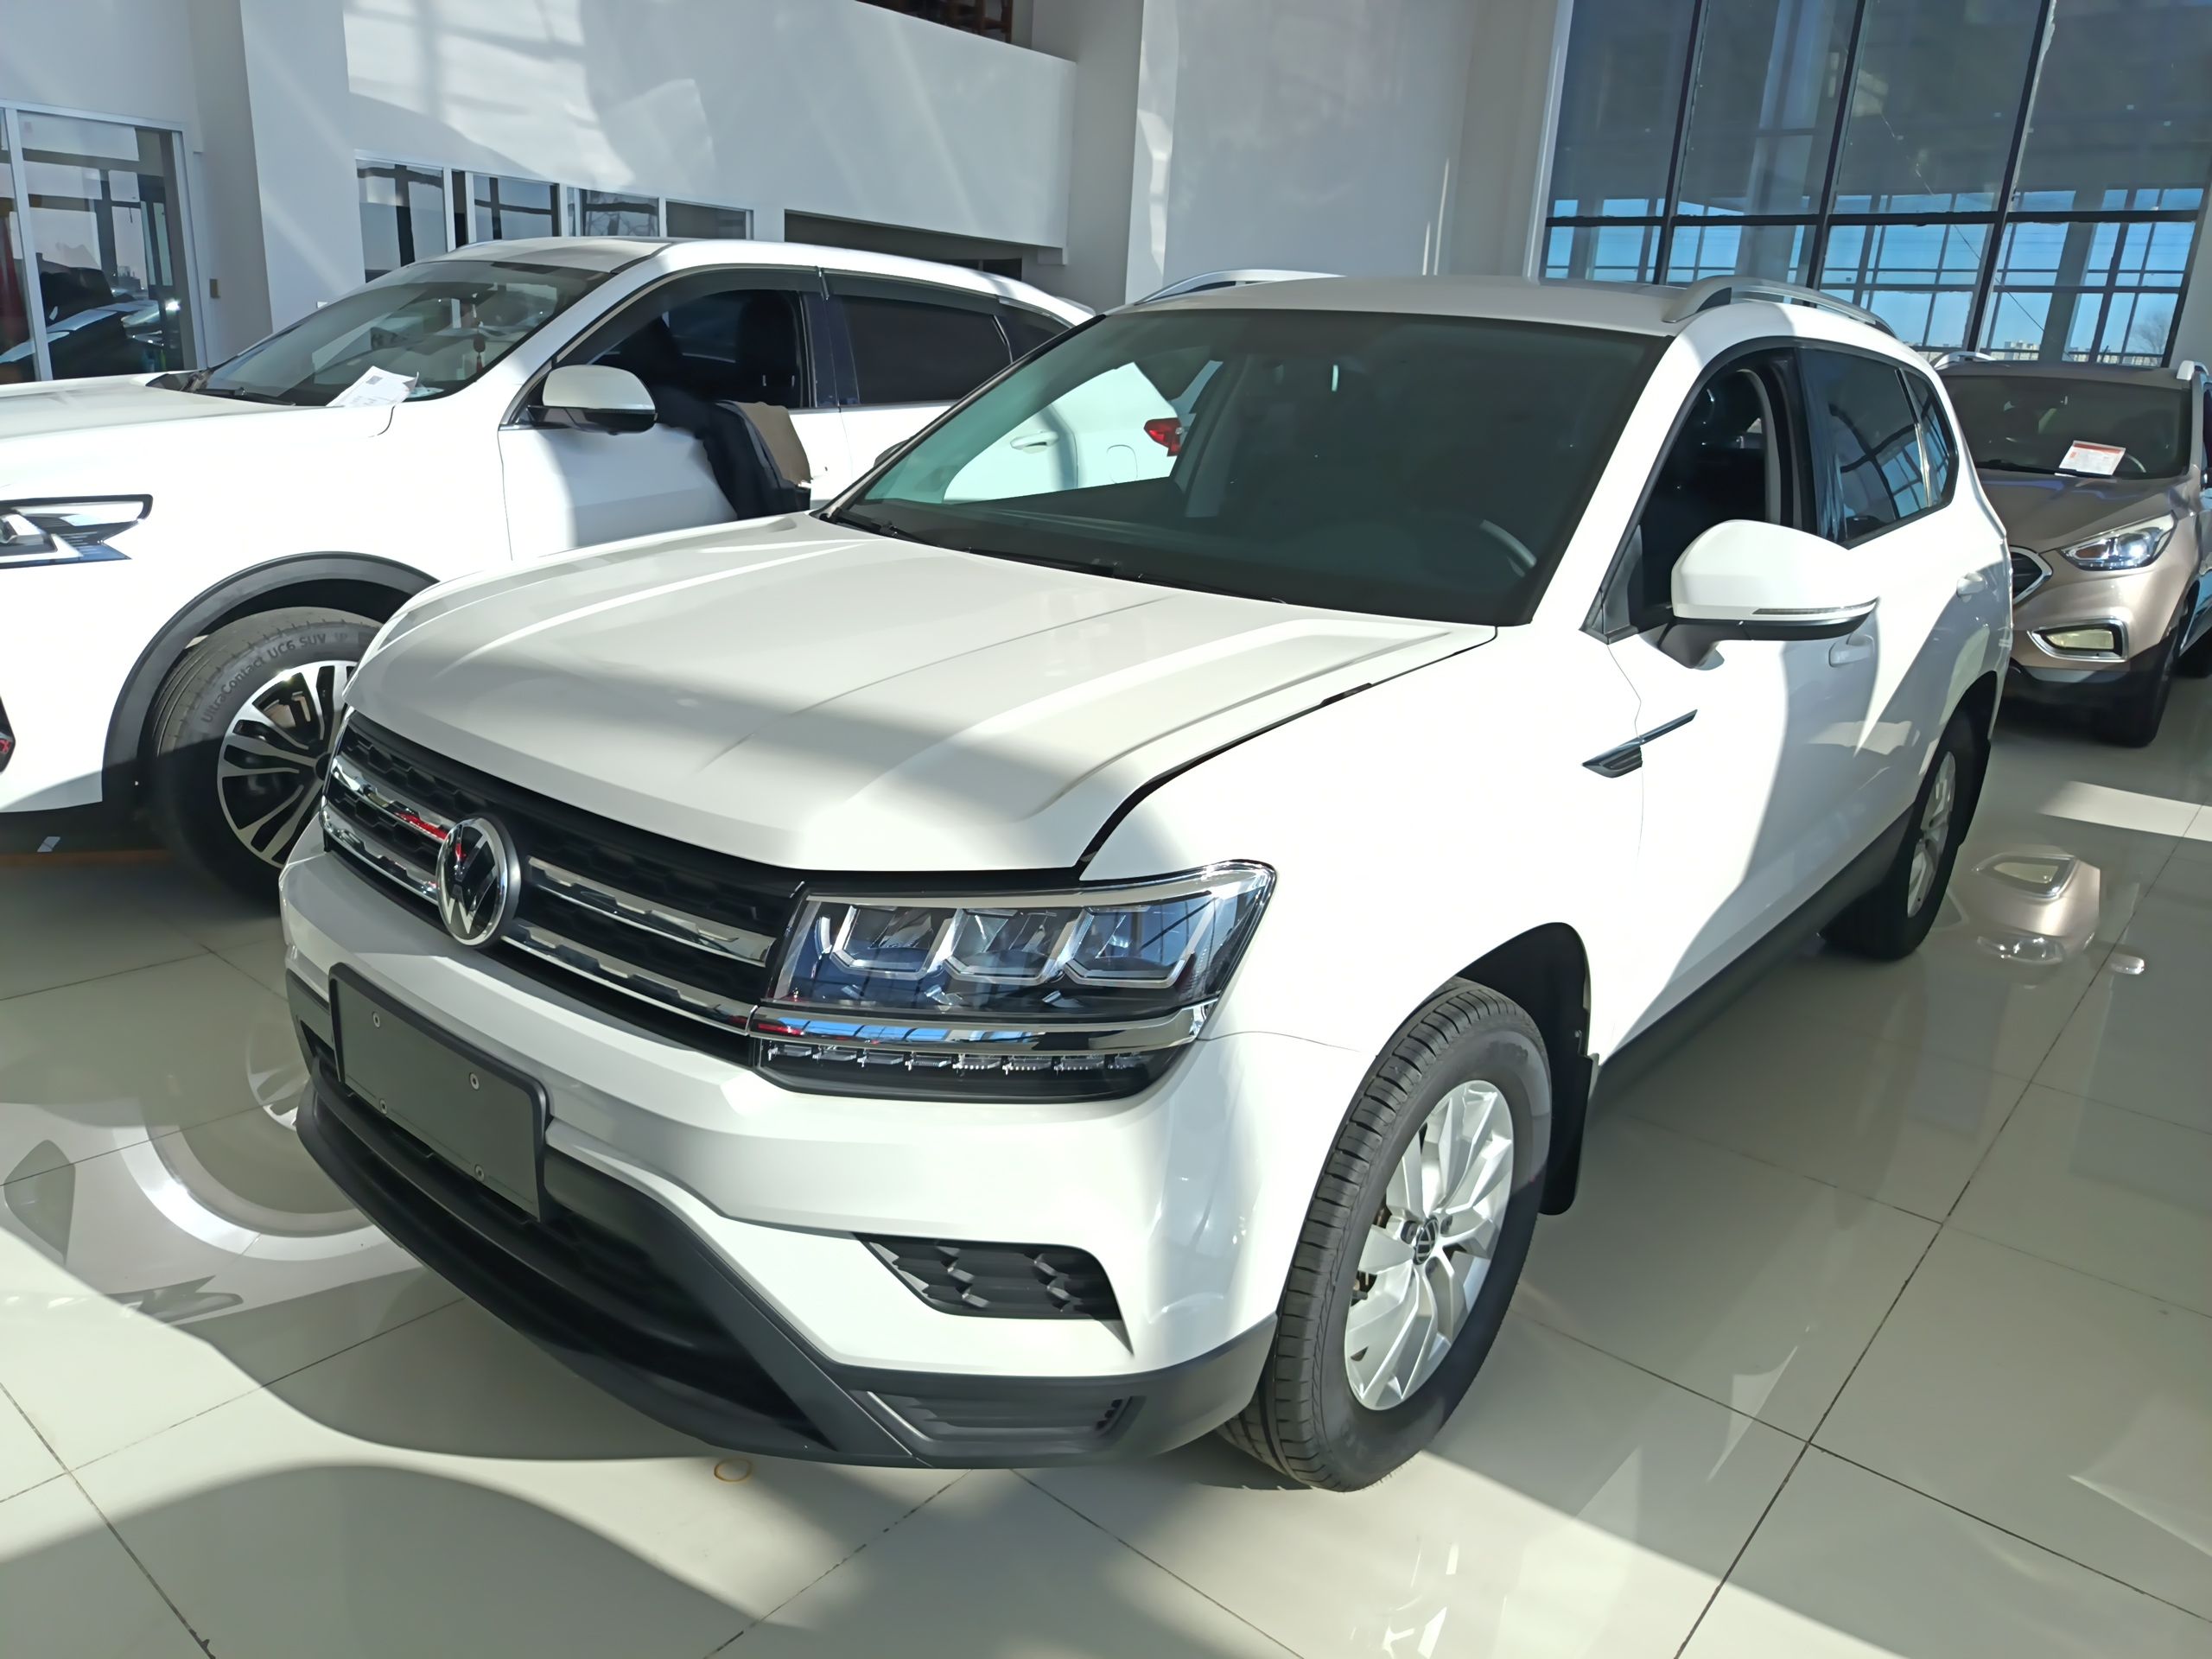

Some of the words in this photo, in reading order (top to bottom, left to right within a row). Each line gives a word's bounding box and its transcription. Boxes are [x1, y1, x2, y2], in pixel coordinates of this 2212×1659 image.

[200, 656, 266, 723] UltraContact
[267, 639, 296, 659] UC6
[300, 632, 326, 647] SUV
